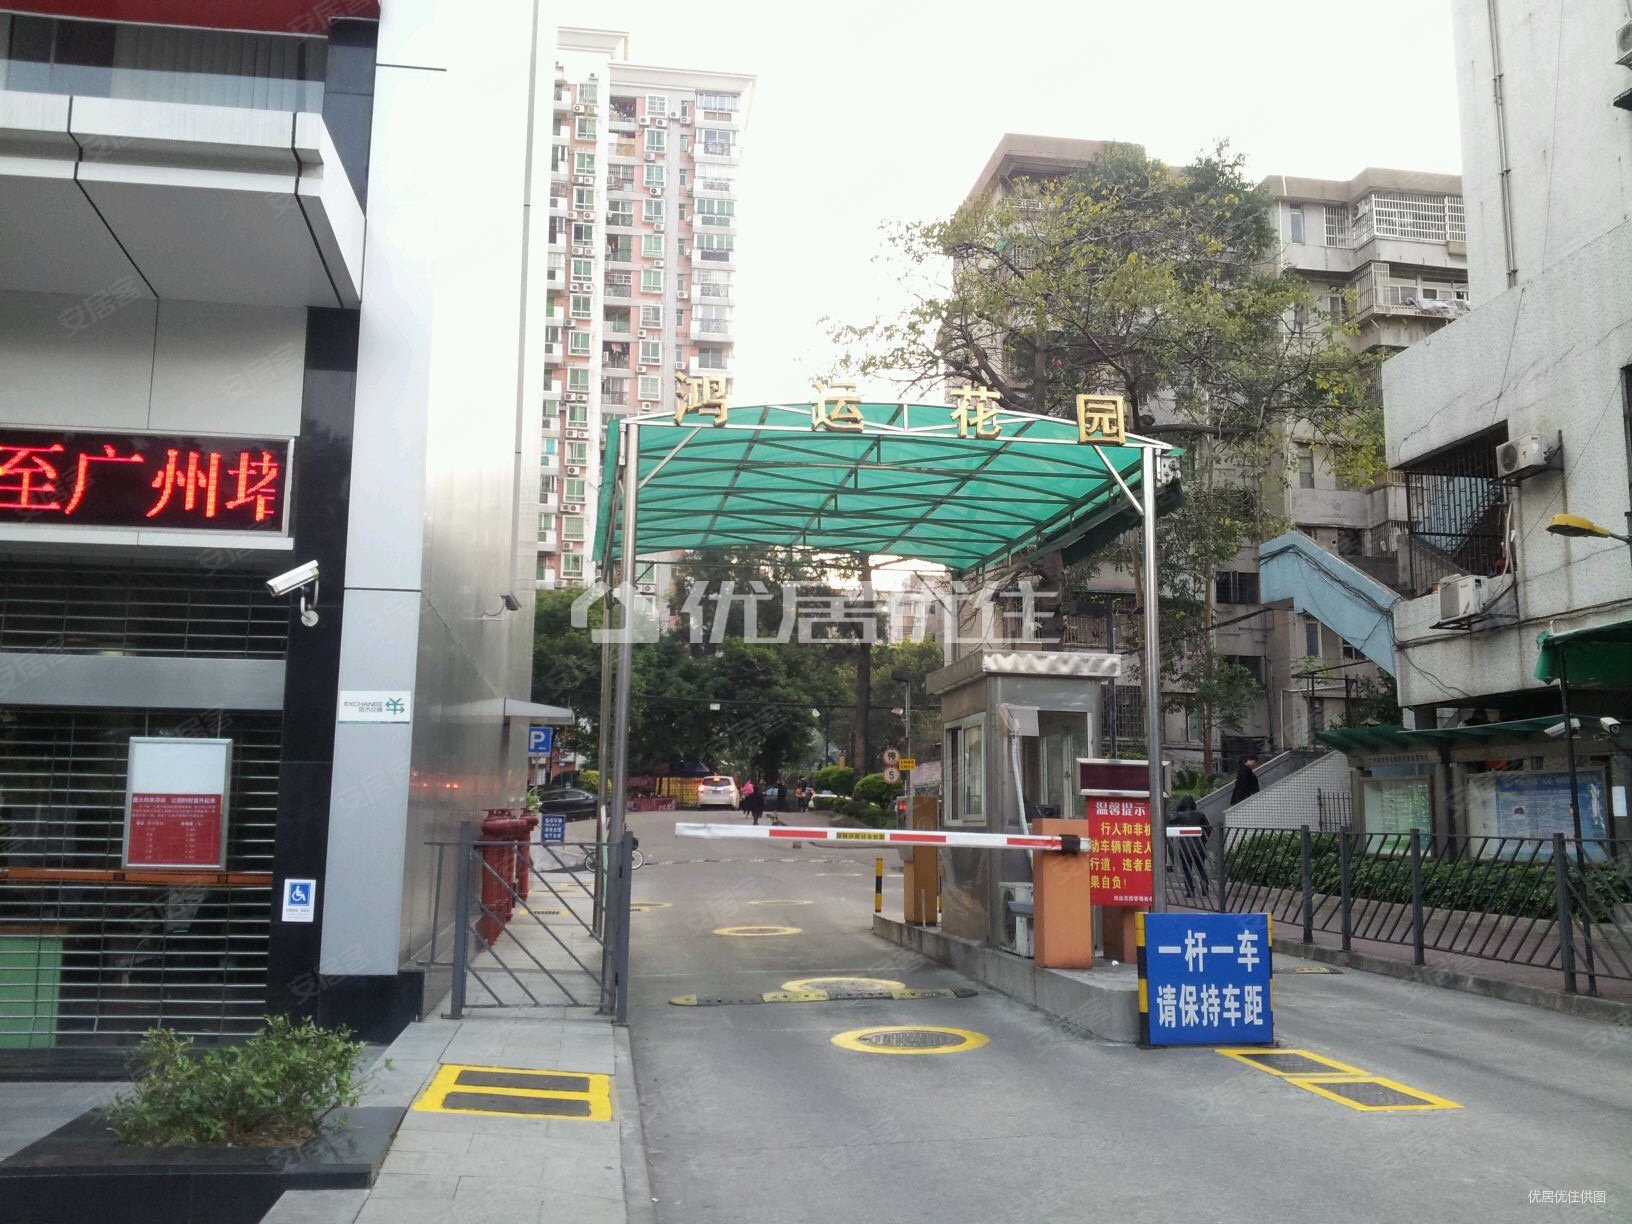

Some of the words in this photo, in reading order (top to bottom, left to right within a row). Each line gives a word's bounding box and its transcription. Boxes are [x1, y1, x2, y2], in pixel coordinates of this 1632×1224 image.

[675, 371, 1127, 446] 鸿运花园
[530, 731, 545, 750] P
[1096, 801, 1146, 817] 温馨提示
[1090, 840, 1152, 854] 动车辆请走人
[1158, 929, 1260, 973] 一杆一车
[1156, 983, 1264, 1029] 请保持车距
